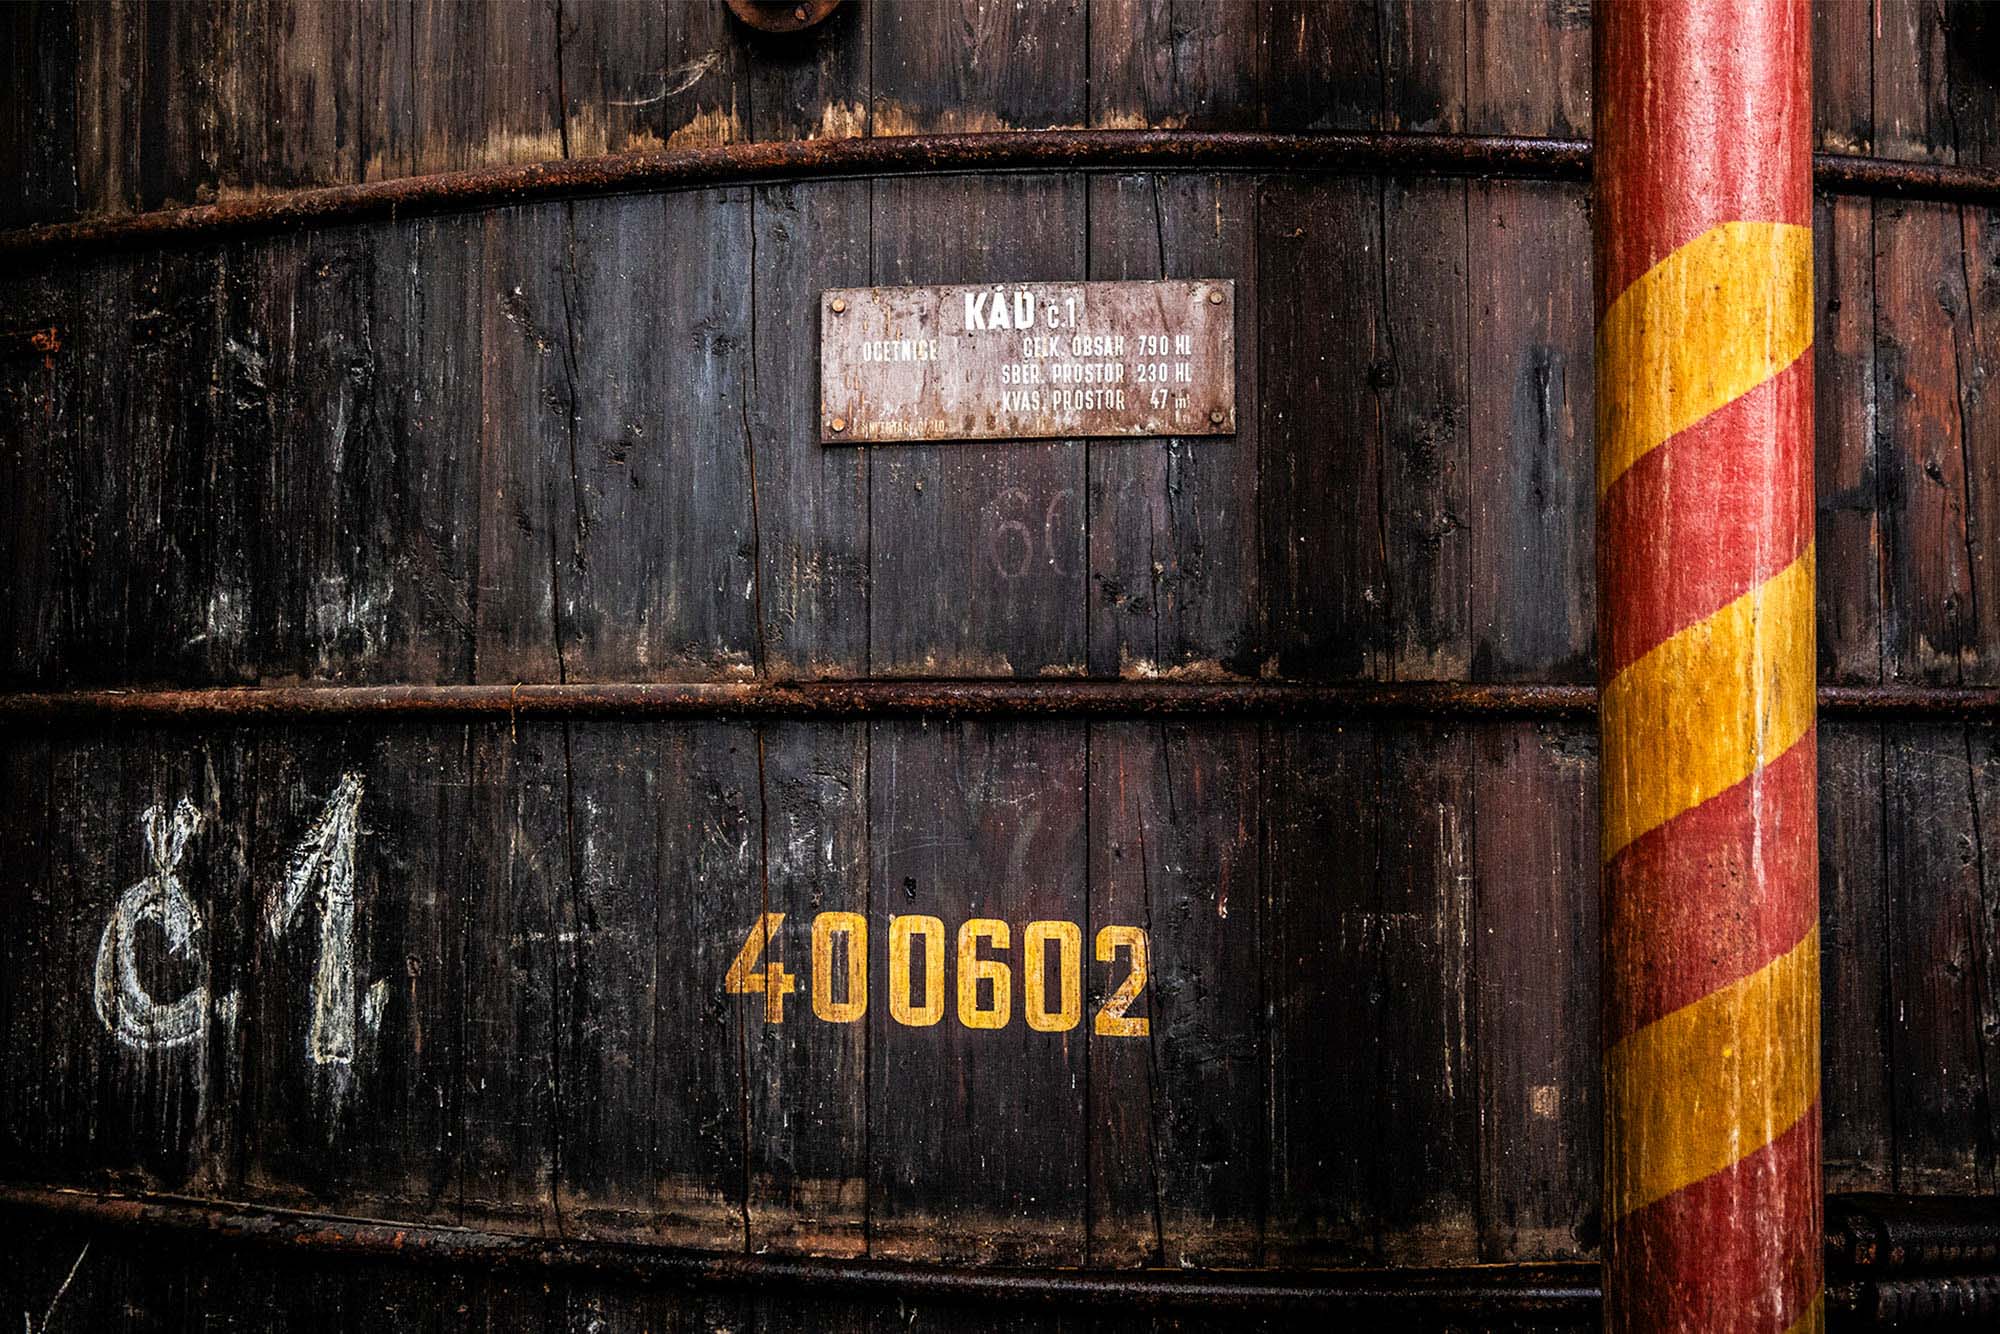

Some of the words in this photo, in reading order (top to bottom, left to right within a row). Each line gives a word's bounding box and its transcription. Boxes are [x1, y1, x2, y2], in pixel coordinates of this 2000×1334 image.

[1047, 297, 1076, 330] č.1
[1072, 335, 1125, 357] OBSAH
[1138, 335, 1169, 356] 790
[1175, 335, 1191, 355] HL
[1002, 360, 1046, 385] SBĚR.
[1052, 363, 1125, 384] PROSTOR
[1137, 363, 1169, 383] 230
[1175, 362, 1192, 383] HL
[1002, 390, 1047, 412] KVAS.
[1053, 389, 1126, 411] PROSTOR
[1151, 389, 1168, 409] 47
[725, 911, 1150, 1036] 400602
